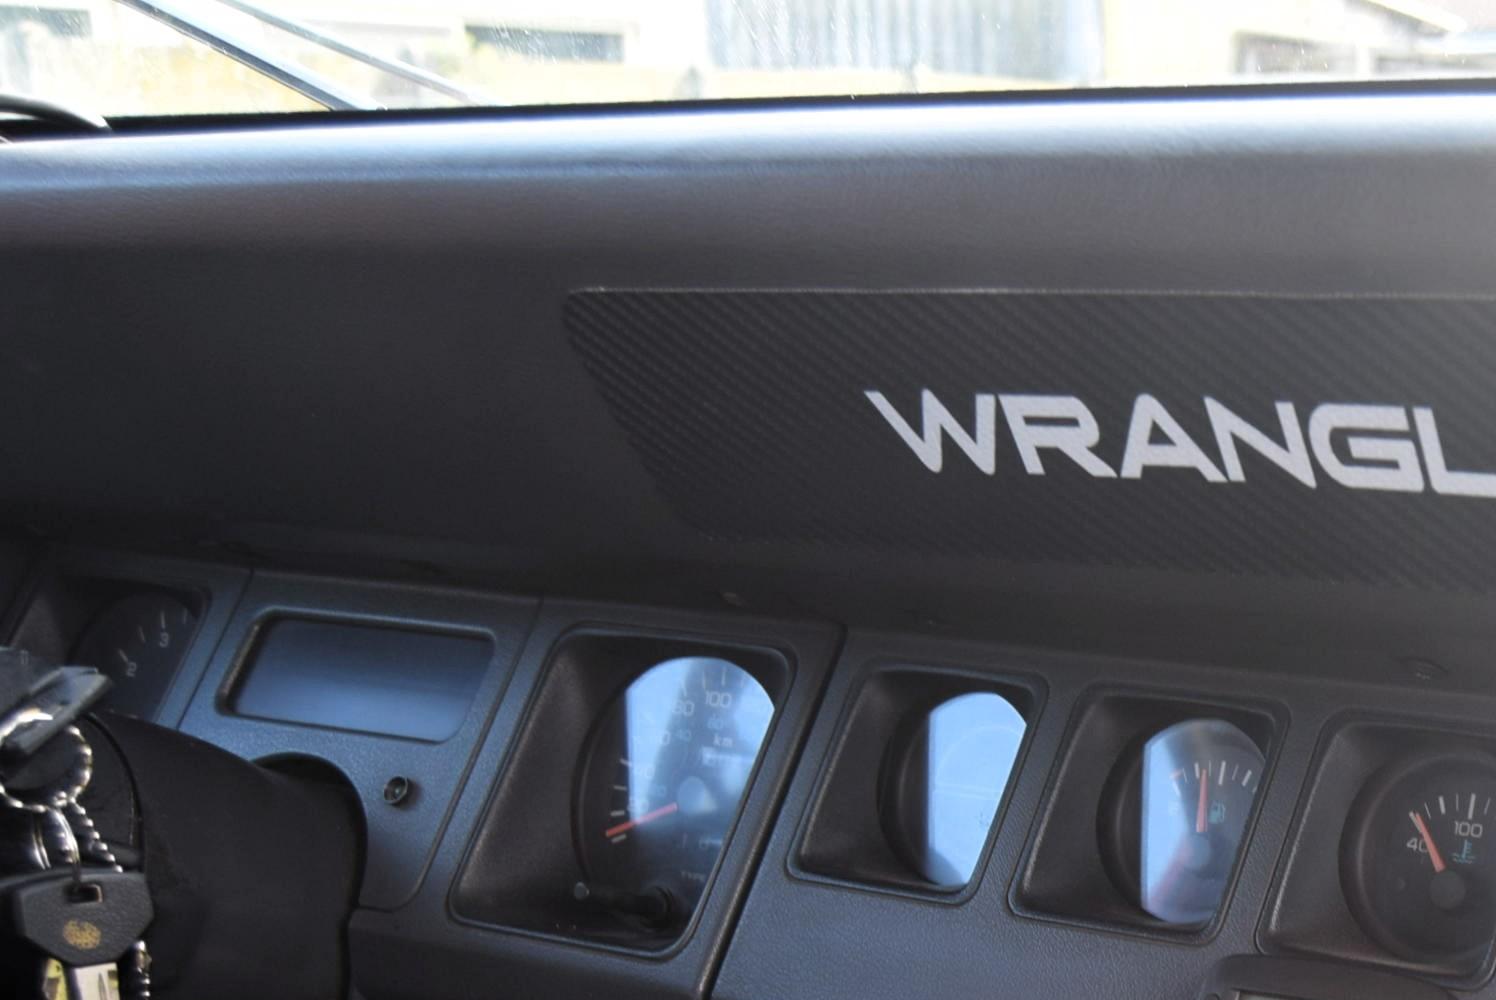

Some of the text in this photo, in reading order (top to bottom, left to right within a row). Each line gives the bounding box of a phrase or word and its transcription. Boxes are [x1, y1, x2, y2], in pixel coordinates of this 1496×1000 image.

[159, 632, 169, 648] 3
[126, 662, 137, 677] 2
[704, 690, 733, 709] 100
[1454, 821, 1483, 839] 100
